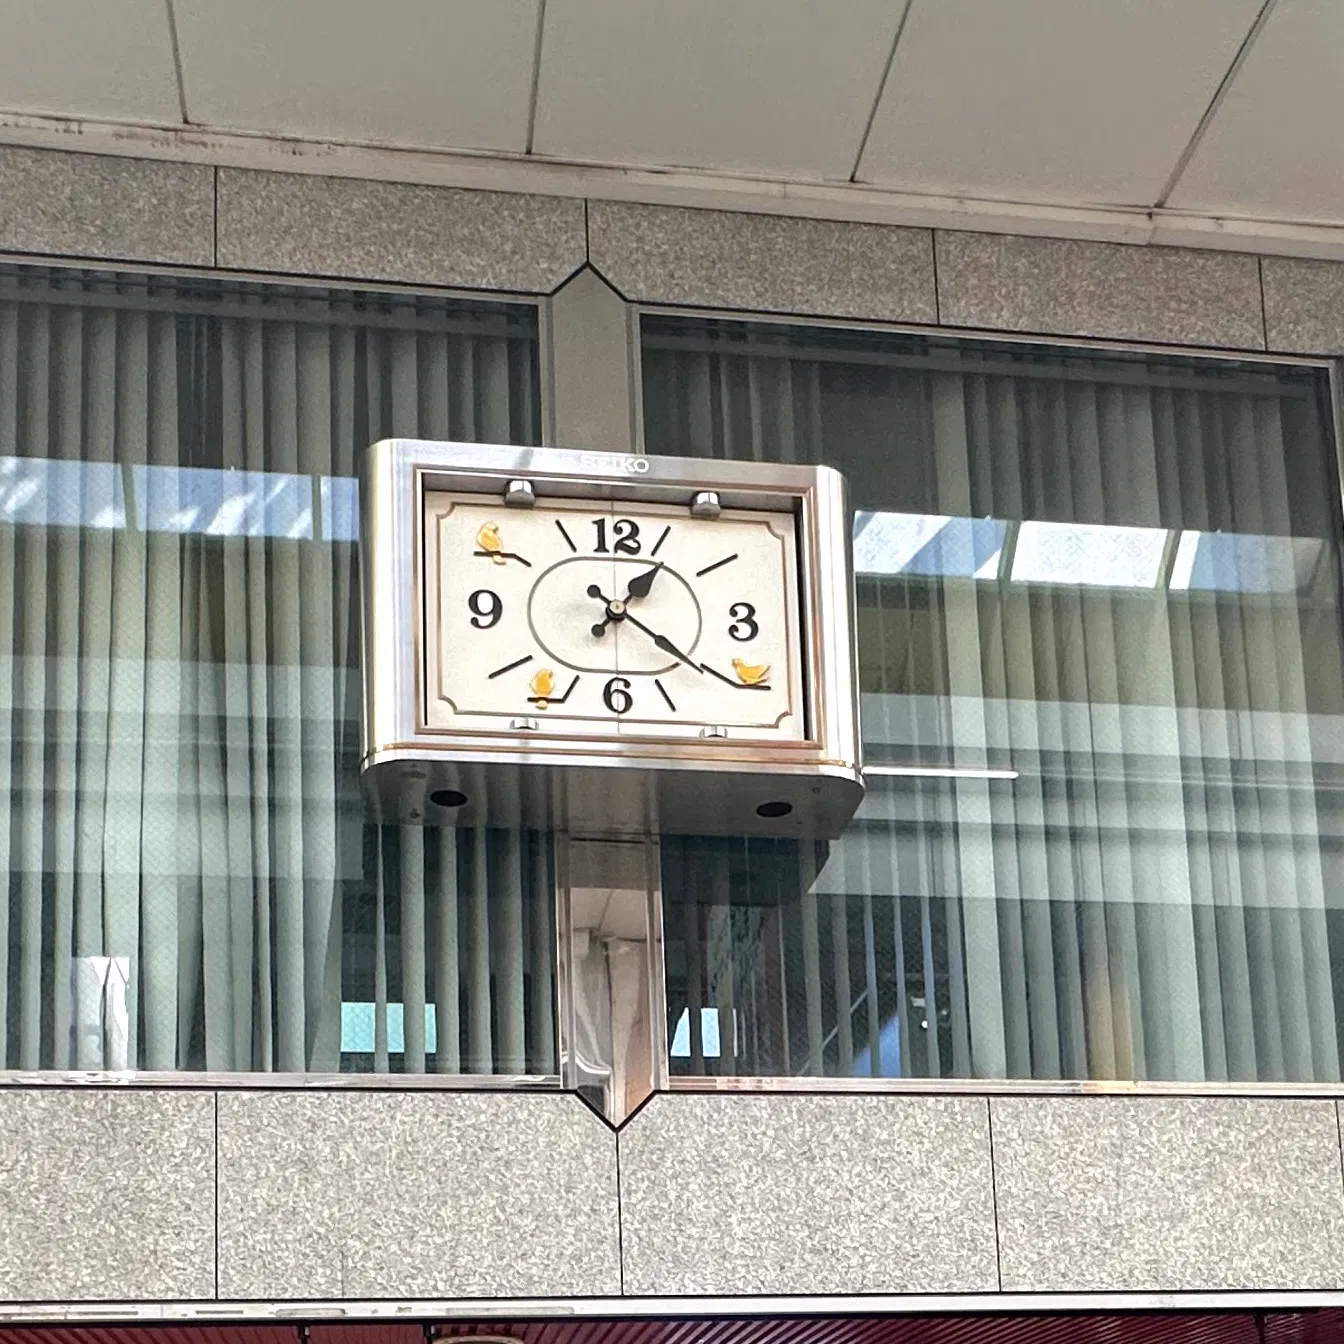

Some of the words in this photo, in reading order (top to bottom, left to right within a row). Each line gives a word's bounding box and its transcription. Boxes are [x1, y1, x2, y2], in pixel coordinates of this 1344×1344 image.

[578, 455, 650, 474] SEIKO
[591, 518, 642, 556] 12
[467, 589, 504, 630] 9
[727, 602, 760, 642] 3
[602, 676, 634, 715] 6
